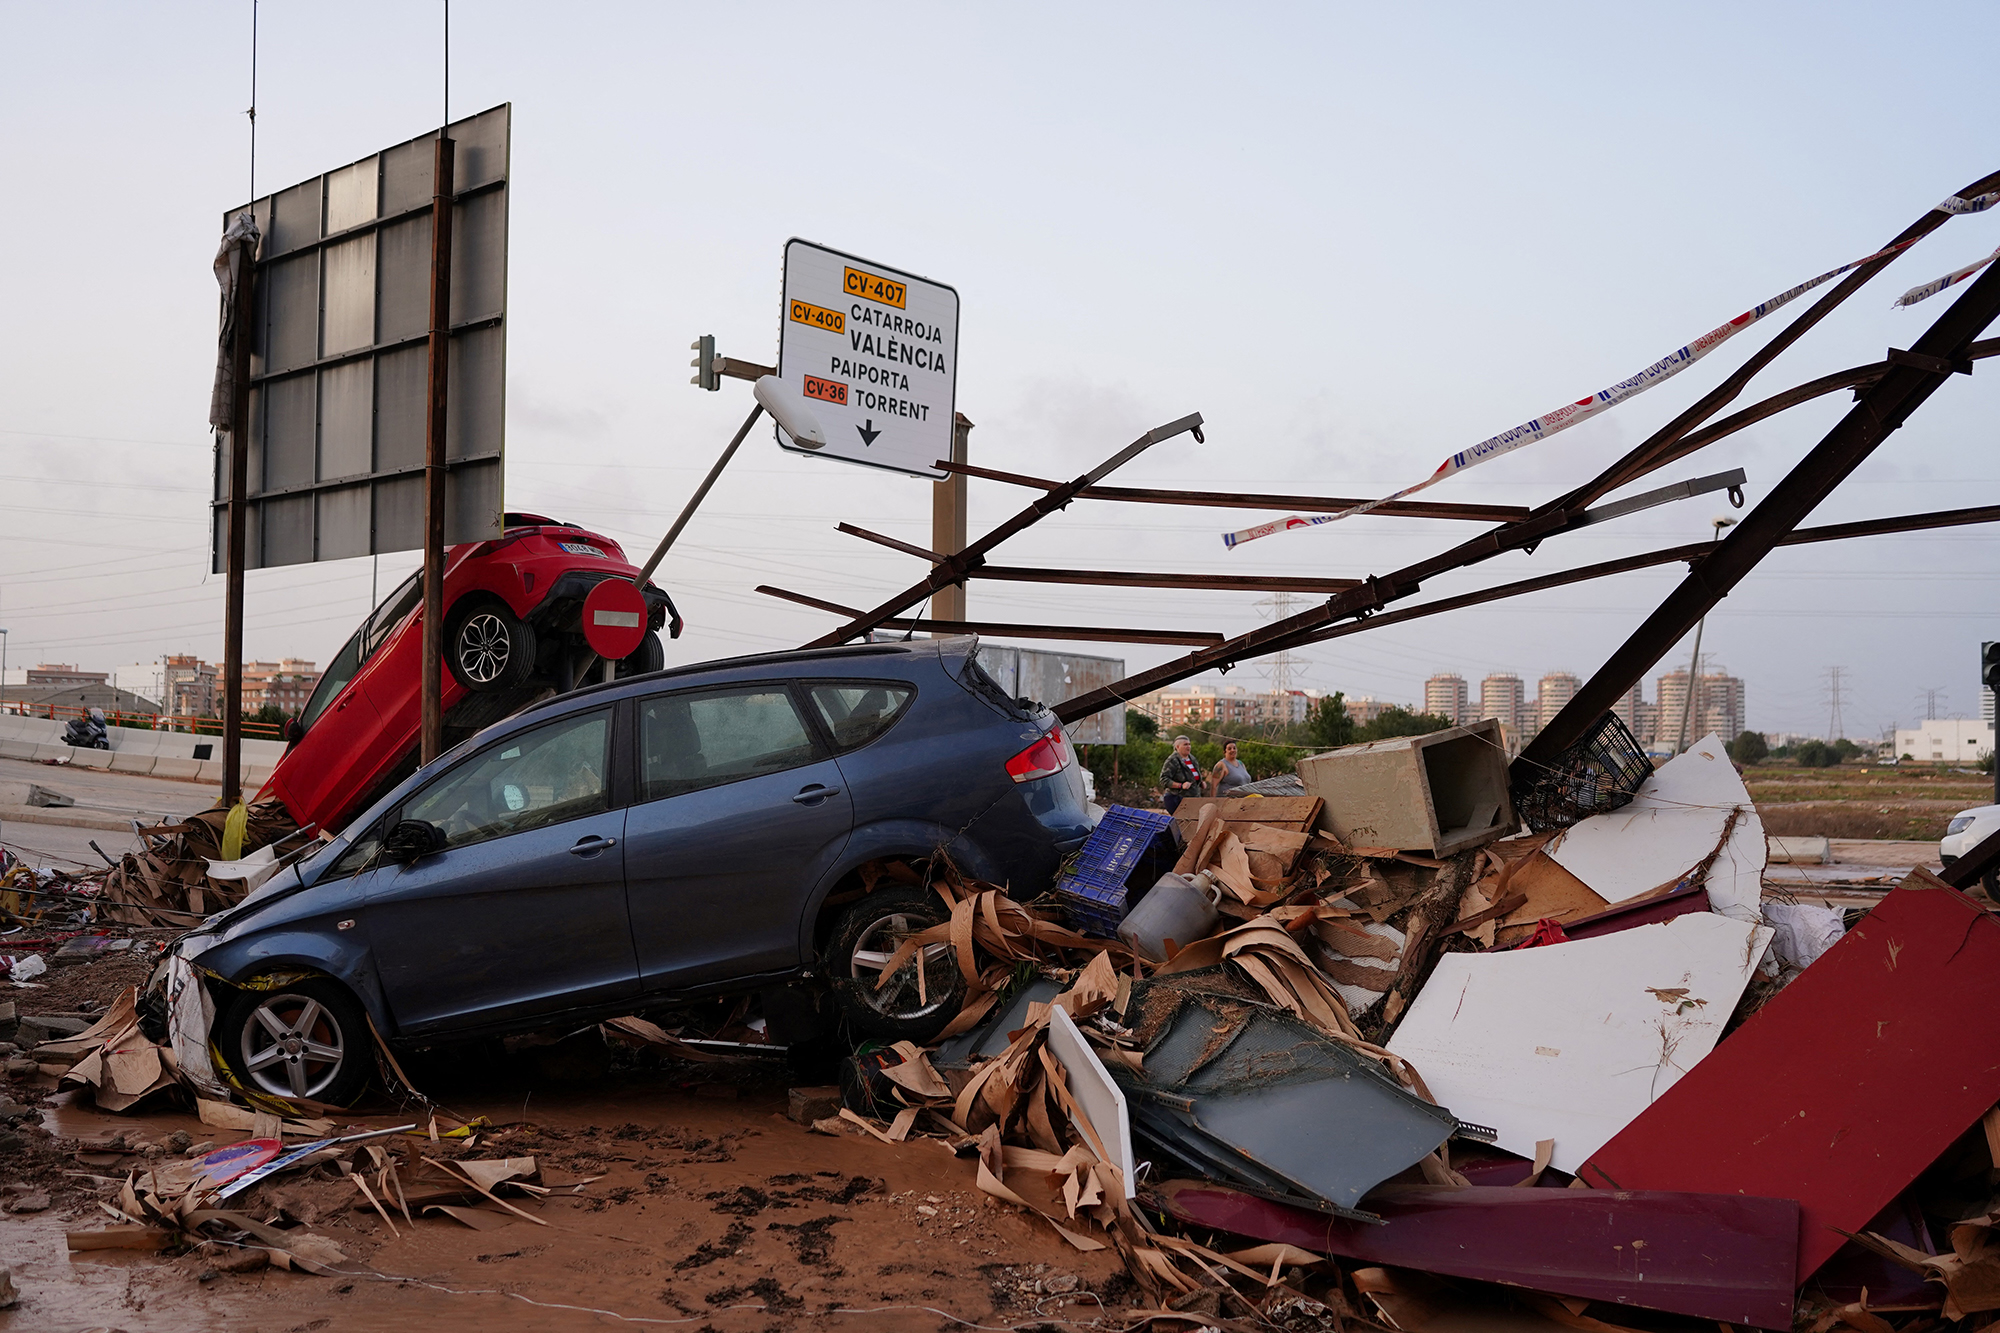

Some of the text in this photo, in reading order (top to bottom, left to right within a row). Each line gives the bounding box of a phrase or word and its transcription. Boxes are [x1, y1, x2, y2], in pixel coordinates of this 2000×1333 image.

[847, 273, 904, 304] CV-407
[793, 304, 843, 330] CV-400
[851, 304, 942, 344] CATARROJA
[850, 329, 946, 374] VALÈNCIA
[807, 380, 845, 401] CV-36
[831, 357, 909, 392] PAIPORTA
[855, 390, 930, 422] TORRENT
